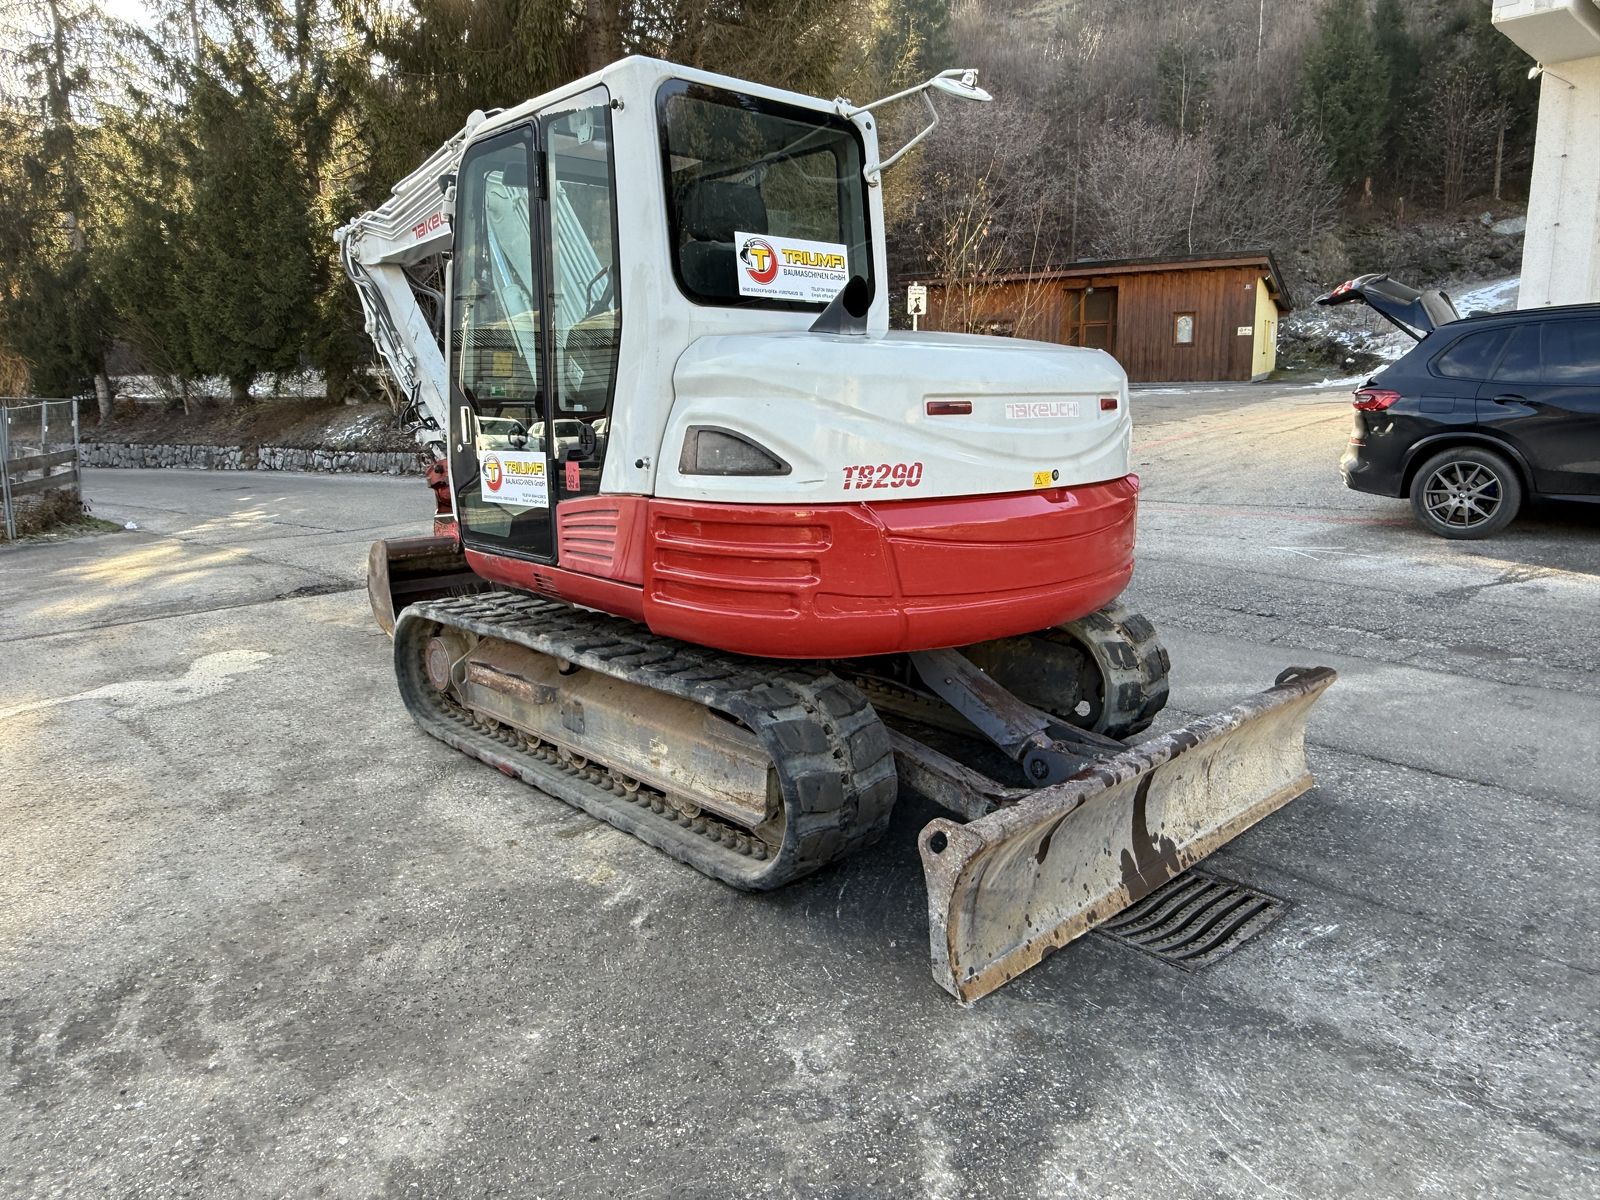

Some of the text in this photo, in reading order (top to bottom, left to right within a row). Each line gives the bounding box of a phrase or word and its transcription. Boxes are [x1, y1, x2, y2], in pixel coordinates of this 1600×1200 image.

[781, 249, 845, 270] TRIUMFI
[783, 269, 846, 281] BAUMASCHINEN GmbH
[504, 461, 545, 477] TRIUMFI
[842, 462, 923, 490] TB290
